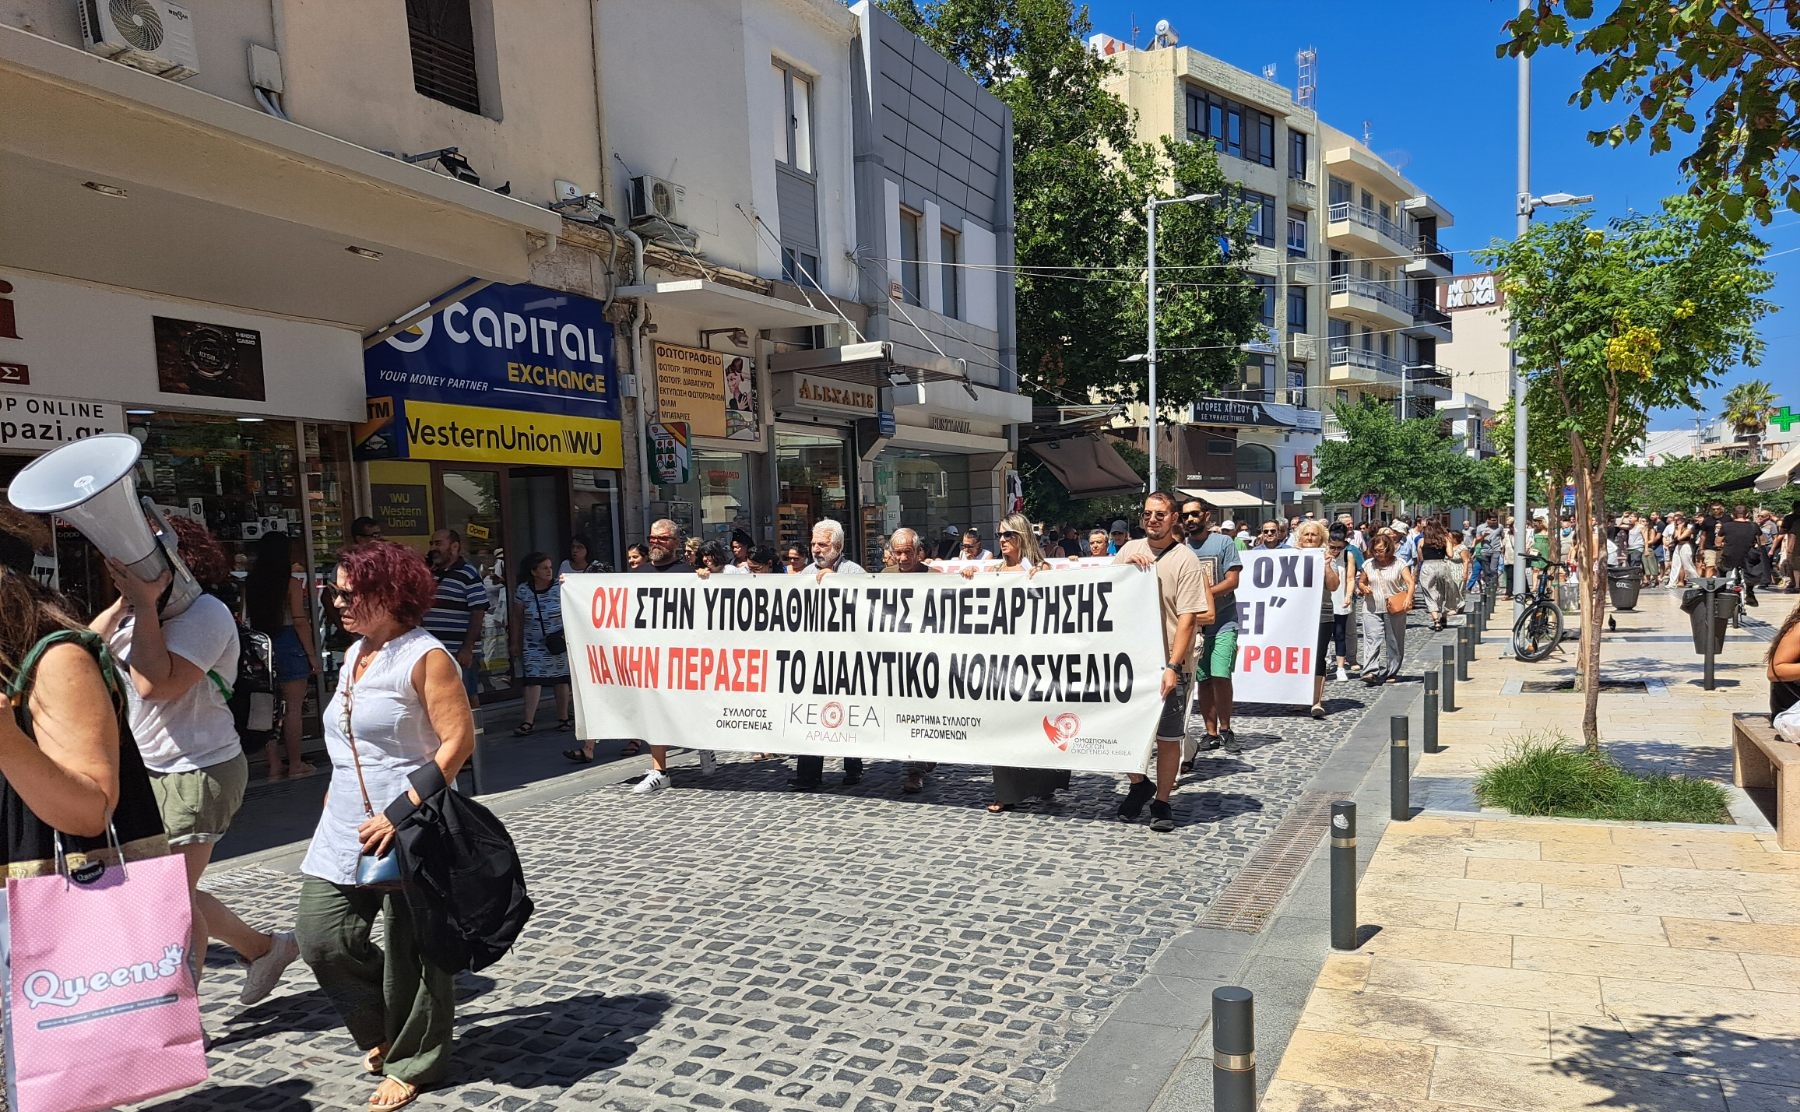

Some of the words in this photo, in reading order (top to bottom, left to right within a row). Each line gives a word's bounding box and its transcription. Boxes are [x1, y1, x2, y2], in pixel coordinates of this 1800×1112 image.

[443, 301, 604, 364] CAPITAL
[656, 346, 722, 366] ΦΩΤΟΓΡΑΦΕΙΟ
[379, 369, 407, 382] YOUR
[409, 373, 446, 386] MONEY
[447, 378, 489, 391] PARTNER
[507, 362, 607, 393] EXCHANGE
[799, 378, 874, 409] ALEXAKIS
[0, 397, 17, 412] P
[26, 399, 104, 418] ONLINE
[1196, 402, 1222, 413] ΑΓΟΡΕΣ
[1224, 402, 1251, 414] ΧΡΥΣΟΥ
[379, 505, 421, 516] Western
[387, 517, 416, 528] Union
[469, 525, 487, 536] Open
[1253, 555, 1314, 589] ΟΧΙ
[591, 586, 629, 629] ΟΧΙ
[634, 587, 695, 630] ΣΤΗΝ
[703, 588, 858, 632] ΥΠΟΒΑΘΜΙΣΗ
[866, 588, 914, 633] ΤΗΣ
[920, 581, 1113, 635] ΑΠΕΞΑΡΤΗΣΗΣ
[1237, 645, 1311, 675] ΡΘΕΙ
[586, 644, 613, 685] ΝΑ
[612, 646, 660, 689] ΜΗΝ
[667, 647, 768, 693] ΠΕΡΑΣΕΙ
[776, 650, 807, 695] ΤΟ
[812, 651, 940, 699] ΔΙΑΛΥΤΙΚΟ
[949, 652, 1134, 704] ΝΟΜΟΣΧΕΔΙΟ
[723, 707, 768, 719] ΣΥΛΛΟΓΟΣ
[896, 714, 941, 726] ΠΑΡΑΡΤΗΜΑ
[942, 716, 982, 728] ΣΥΛΛΟΓΟΥ
[716, 719, 773, 732] ΟΙΚΟΓΕΝΕΙΑΣ
[911, 728, 967, 741] ΕΡΓΑΖΟΜΕΝΩΝ
[805, 730, 858, 744] ΑΡΙΑΔΝΗ
[1074, 737, 1118, 745] ΟΜΟΣΠΟΝΔΙΑ
[22, 956, 178, 1010] Queens
